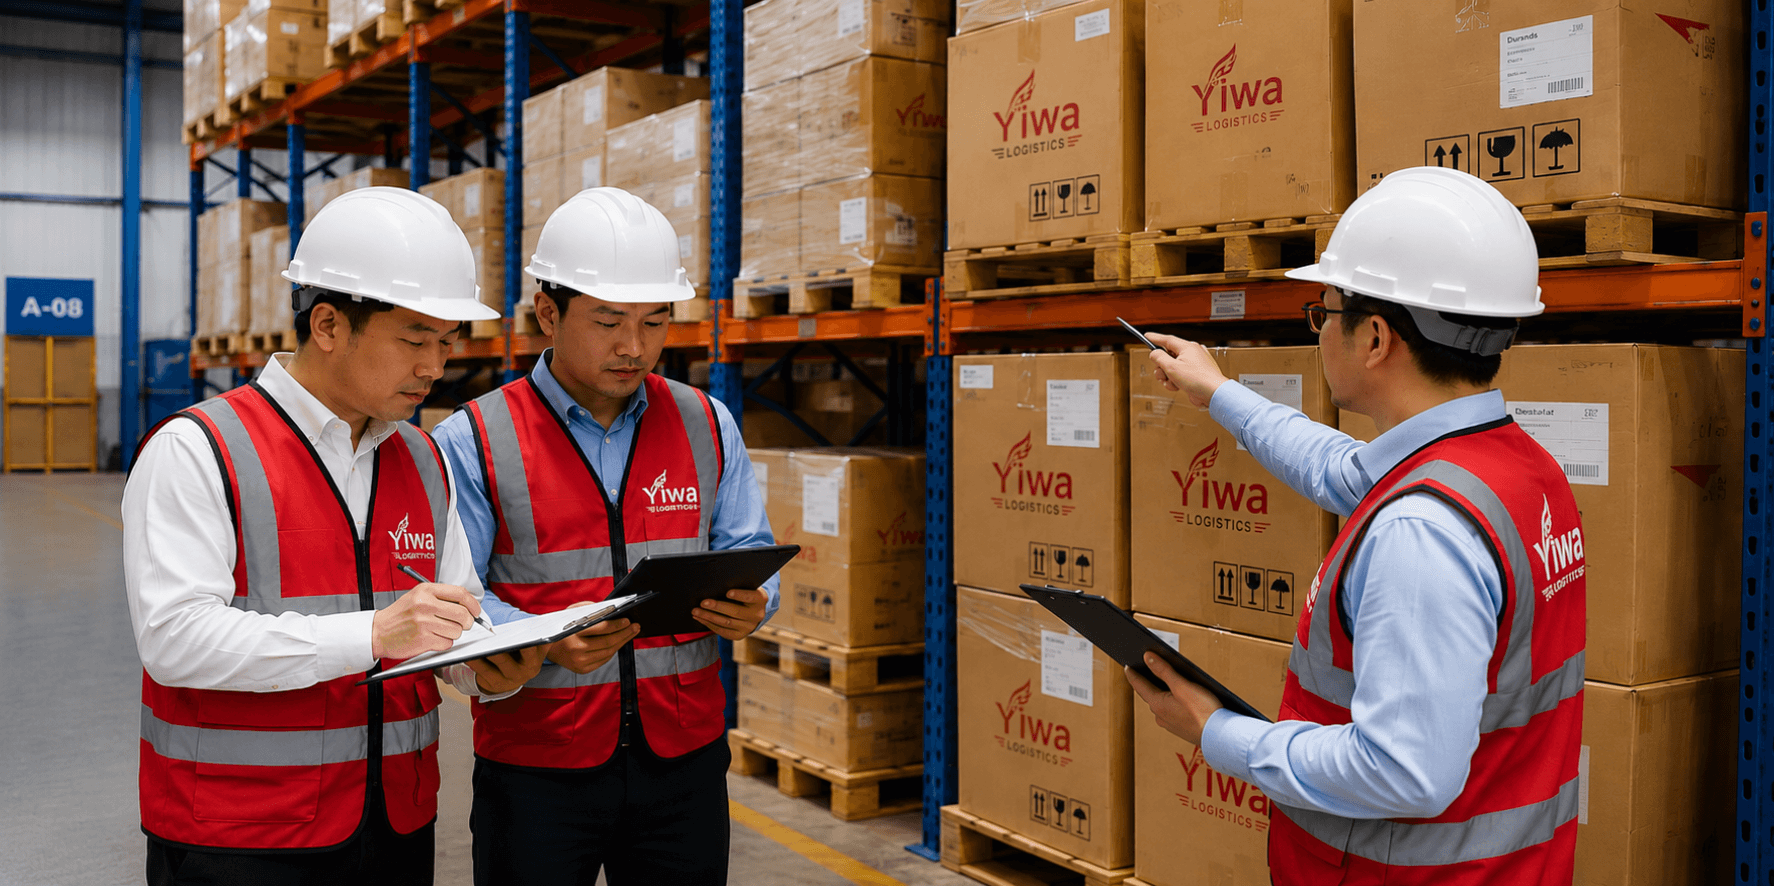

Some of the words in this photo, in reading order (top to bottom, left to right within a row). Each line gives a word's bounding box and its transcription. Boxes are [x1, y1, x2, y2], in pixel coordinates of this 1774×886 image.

[1191, 76, 1283, 117] Yiwa
[993, 102, 1080, 143] Yiwa
[1206, 112, 1267, 132] LOGISTICS
[1006, 138, 1065, 158] LOGISTICS
[20, 296, 83, 319] A-08
[992, 461, 1073, 500] Yiwa
[1171, 470, 1268, 515] Yiwa
[1005, 499, 1060, 516] LOGISTICS
[1187, 513, 1251, 533] LOGISTICS
[1532, 527, 1585, 582] Yiwa
[995, 701, 1071, 753] Yiwa
[1007, 740, 1059, 766] LOGISTICS
[1175, 750, 1268, 817] Yiwa
[1191, 800, 1253, 829] LOGISTICS
